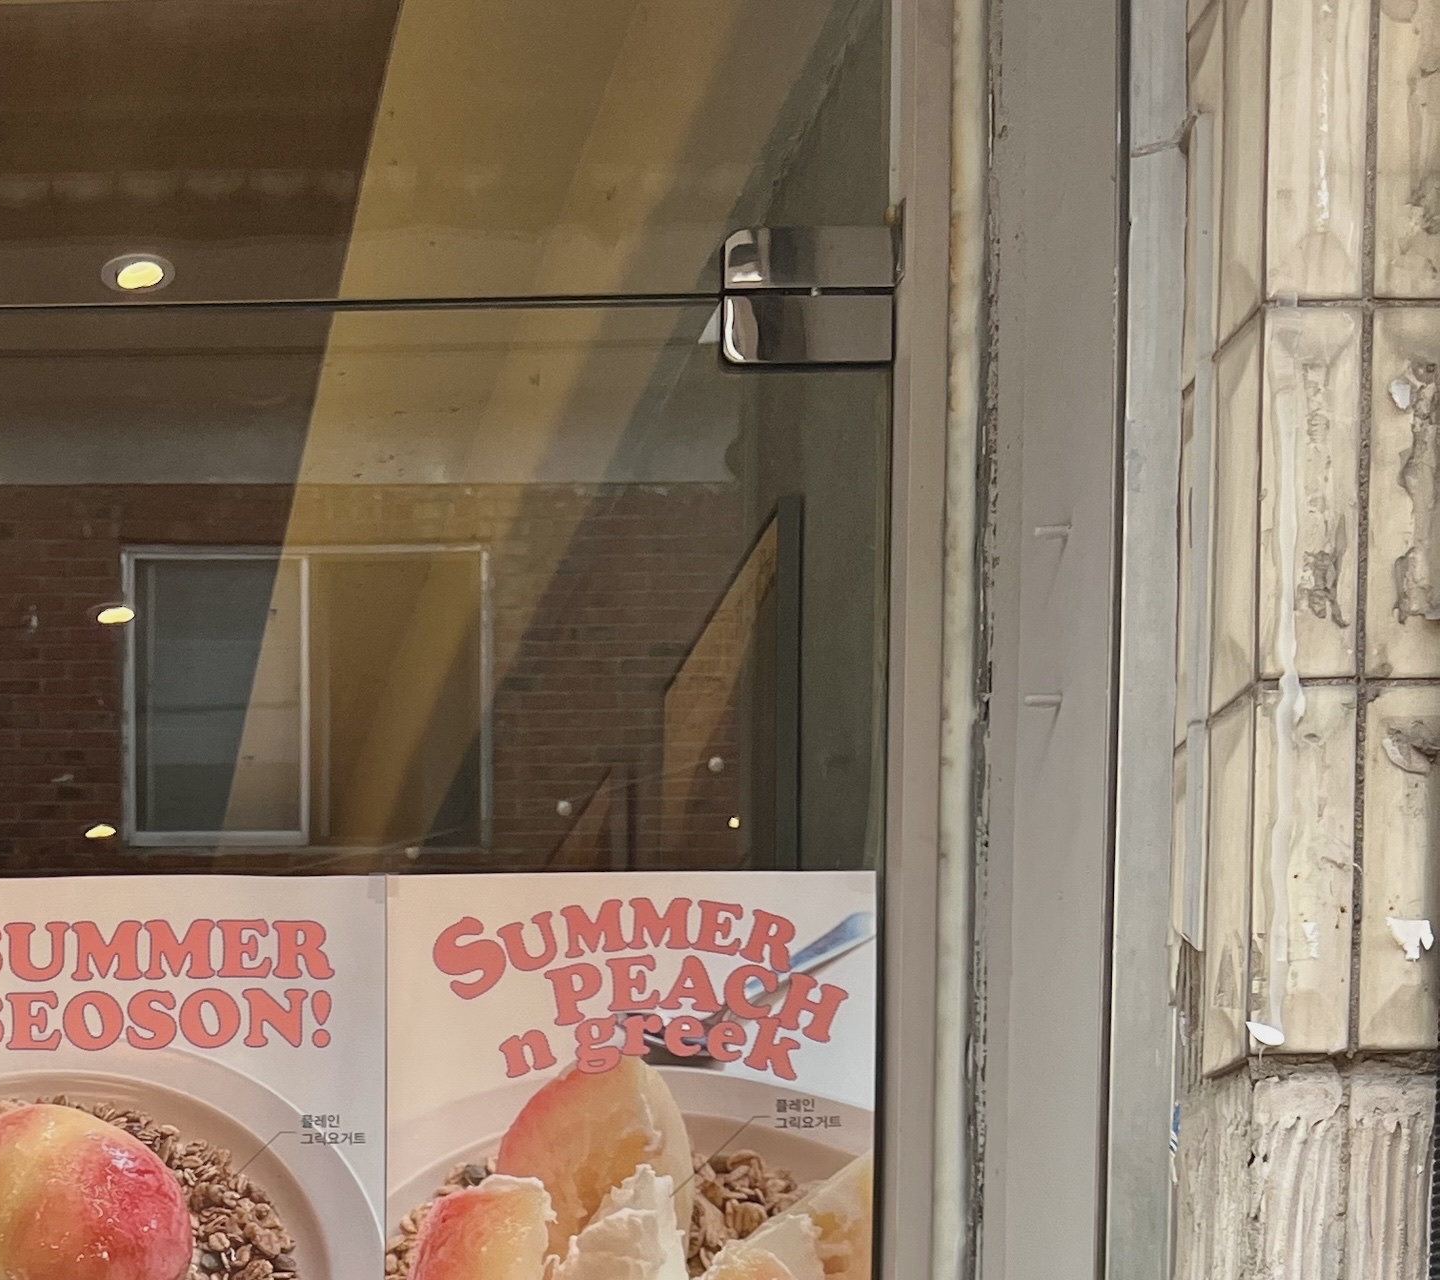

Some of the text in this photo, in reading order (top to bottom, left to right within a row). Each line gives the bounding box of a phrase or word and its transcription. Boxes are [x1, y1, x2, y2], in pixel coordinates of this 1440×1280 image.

[432, 897, 798, 1000] SUMMER
[544, 955, 849, 1043] PEACH
[498, 1012, 799, 1081] n greek
[776, 1098, 815, 1113] 플레인
[301, 1114, 340, 1128] 플레인
[774, 1115, 842, 1129] 그릭요거트
[300, 1132, 366, 1146] 그릭요거트
